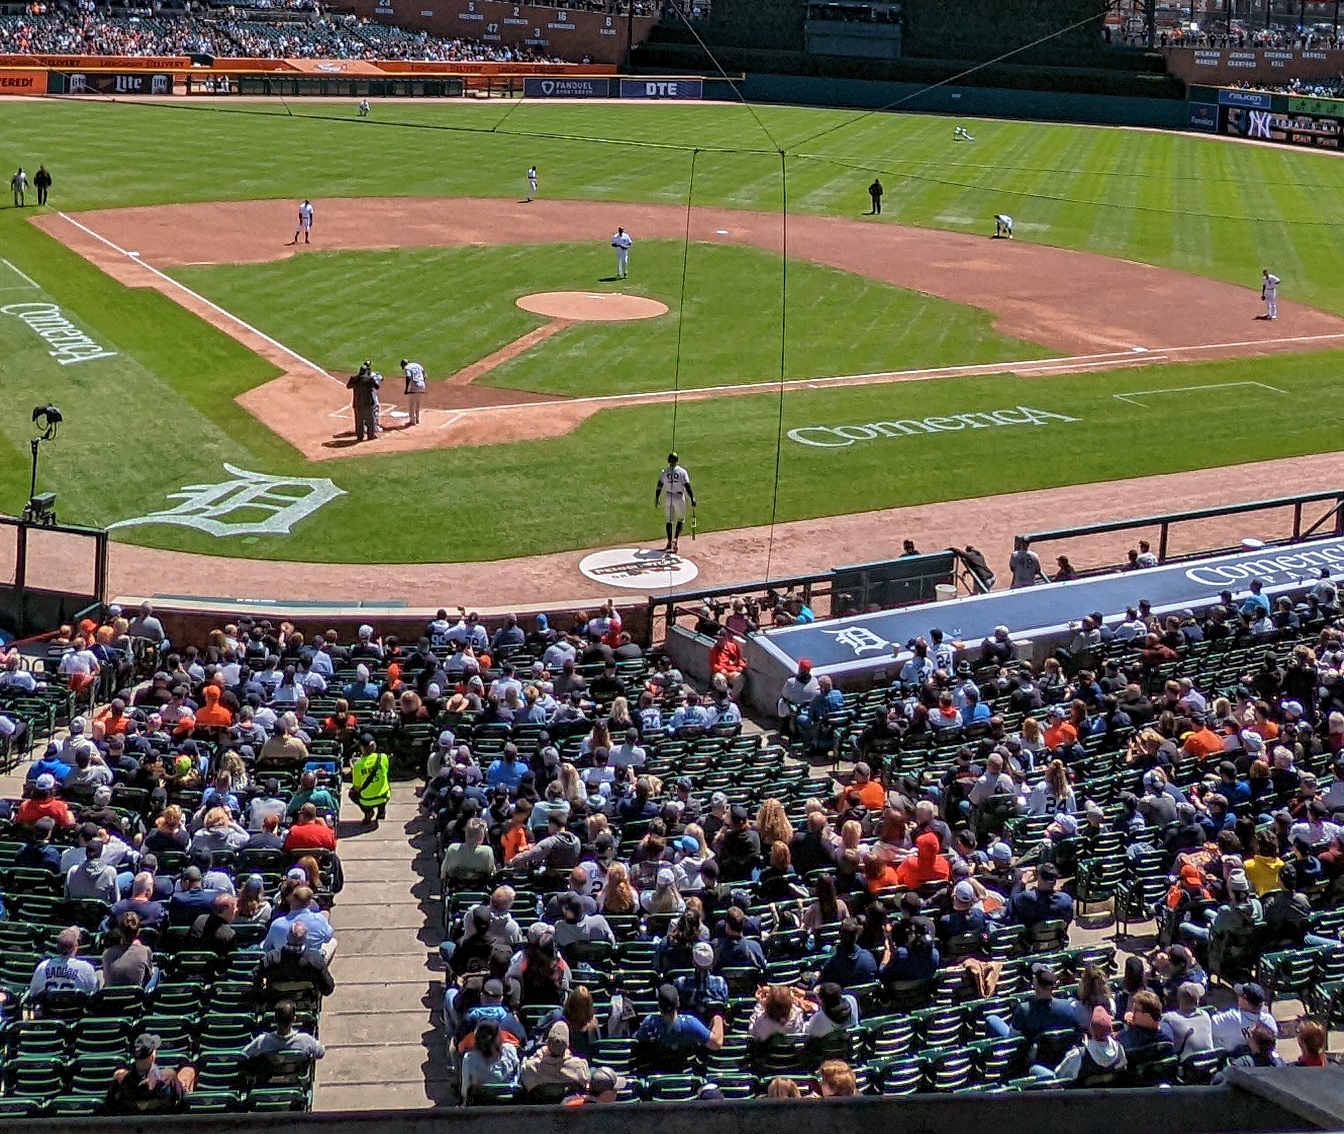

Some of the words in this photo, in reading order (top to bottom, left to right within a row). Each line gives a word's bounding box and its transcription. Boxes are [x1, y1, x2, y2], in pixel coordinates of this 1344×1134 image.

[468, 2, 475, 12] 5
[513, 6, 520, 17] 2
[557, 11, 567, 21] 16
[605, 16, 612, 27] 6
[486, 23, 499, 33] 47
[533, 28, 541, 38] 3
[115, 75, 142, 93] Lite
[555, 81, 594, 90] FANDUEL
[645, 81, 678, 96] DTE
[936, 652, 952, 669] 24
[1045, 796, 1068, 814] 24
